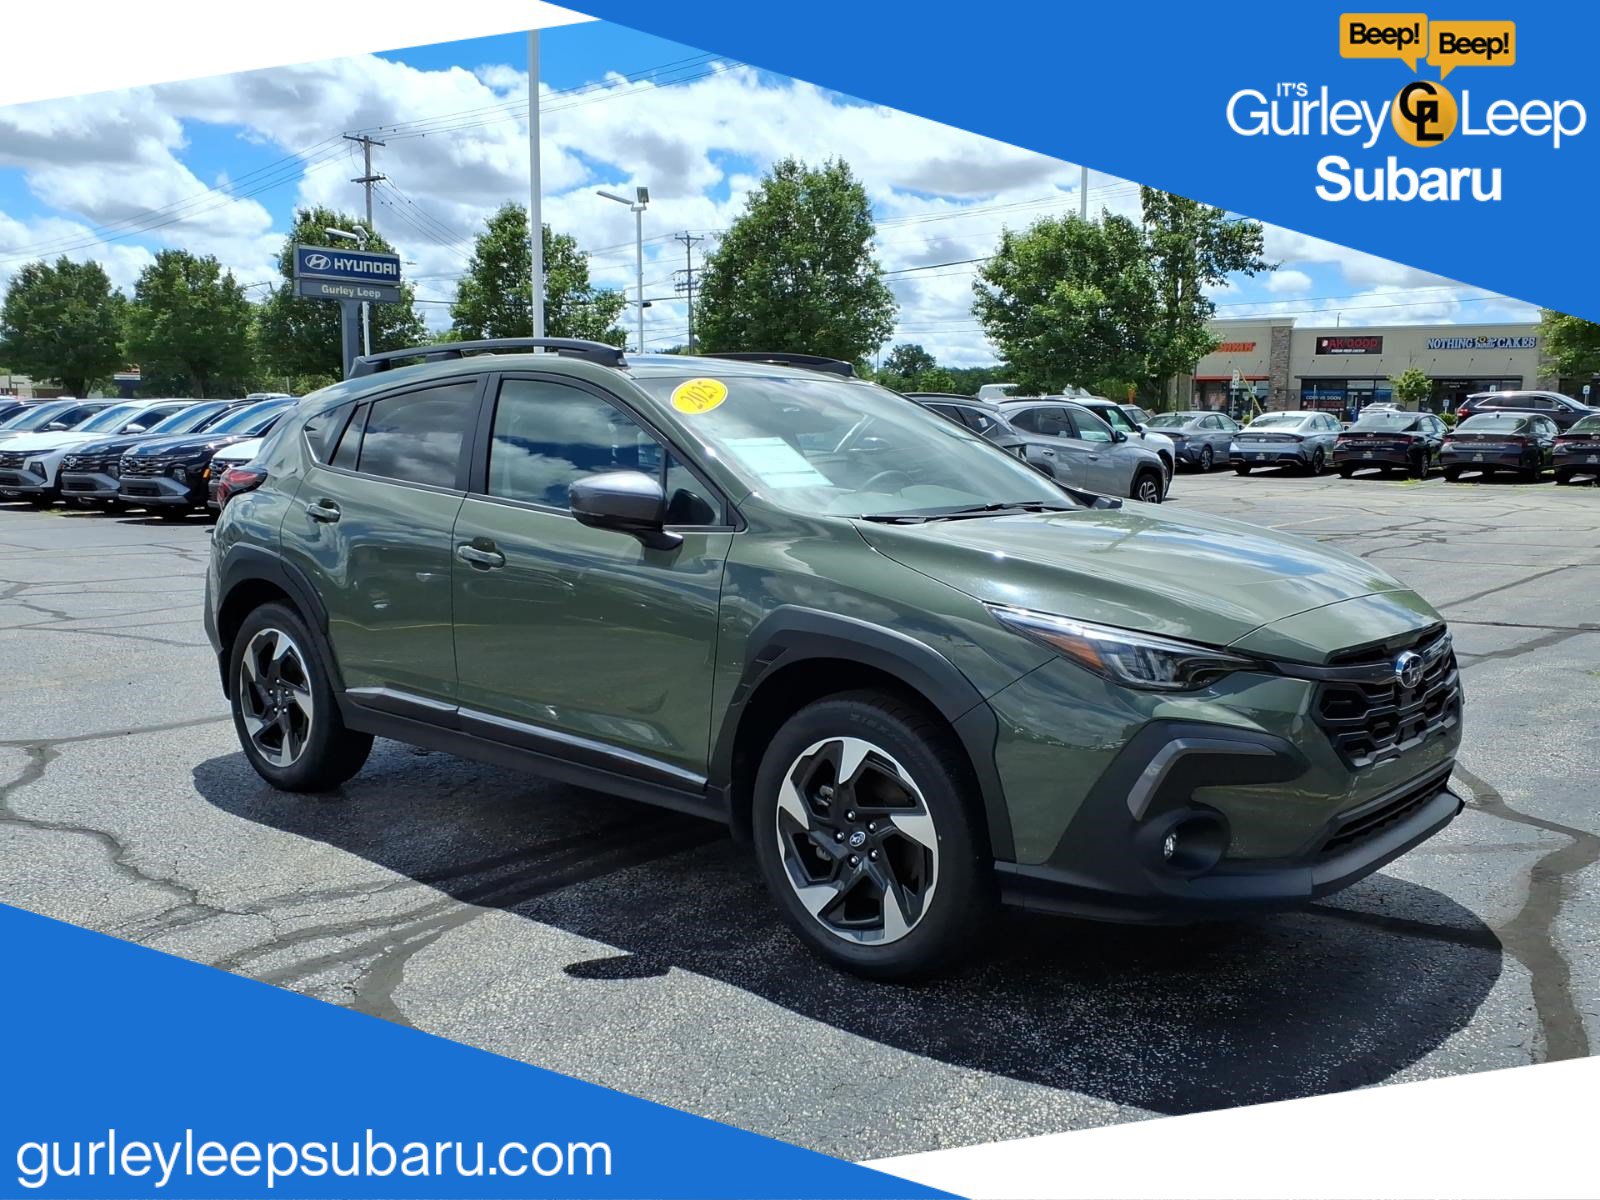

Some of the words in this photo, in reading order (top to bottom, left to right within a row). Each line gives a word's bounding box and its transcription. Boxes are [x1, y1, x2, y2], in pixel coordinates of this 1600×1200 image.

[334, 258, 397, 275] HYUNDAI
[321, 284, 354, 298] Gurley
[357, 286, 381, 299] Leep
[1427, 337, 1475, 350] NOTHING
[1497, 336, 1538, 350] CAKES
